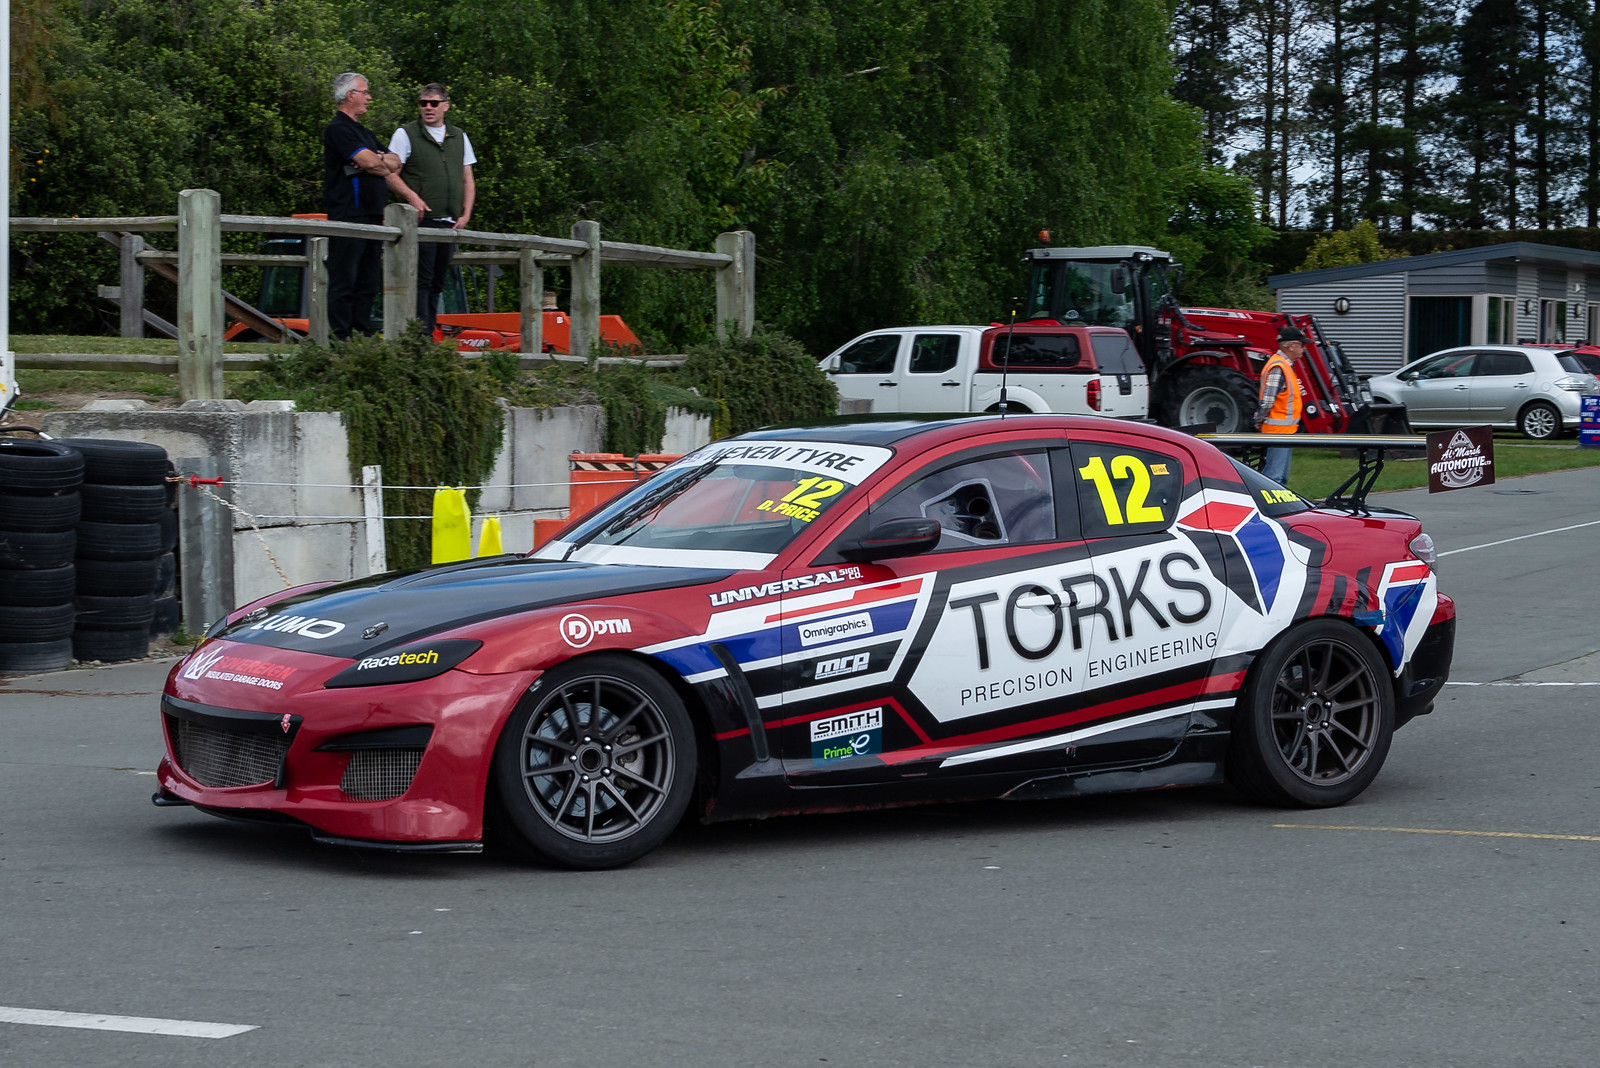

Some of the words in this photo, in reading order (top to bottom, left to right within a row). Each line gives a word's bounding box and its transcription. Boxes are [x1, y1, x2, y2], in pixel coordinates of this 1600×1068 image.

[704, 446, 792, 461] NEXEN
[785, 448, 865, 472] TYRE
[1431, 456, 1486, 474] AUTOMOTIVE
[780, 476, 844, 509] 12
[1079, 455, 1164, 525] 12
[757, 500, 774, 511] D.
[772, 502, 820, 522] PRICE
[849, 572, 864, 580] CO.
[709, 570, 846, 606] UNIVERSAL
[949, 552, 1212, 670] TORKS
[250, 615, 345, 639] LUMO
[594, 619, 632, 635] DTM
[803, 620, 867, 639] Omnigraphics
[214, 656, 298, 679] SOVEREIGN
[357, 650, 439, 671] Racetech
[961, 666, 1074, 706] PRECISION
[1088, 631, 1218, 678] ENGINEERING
[205, 671, 235, 681] INSULATED
[233, 674, 260, 685] GARAGE
[258, 679, 284, 690] DOORS
[824, 746, 853, 760] Prime
